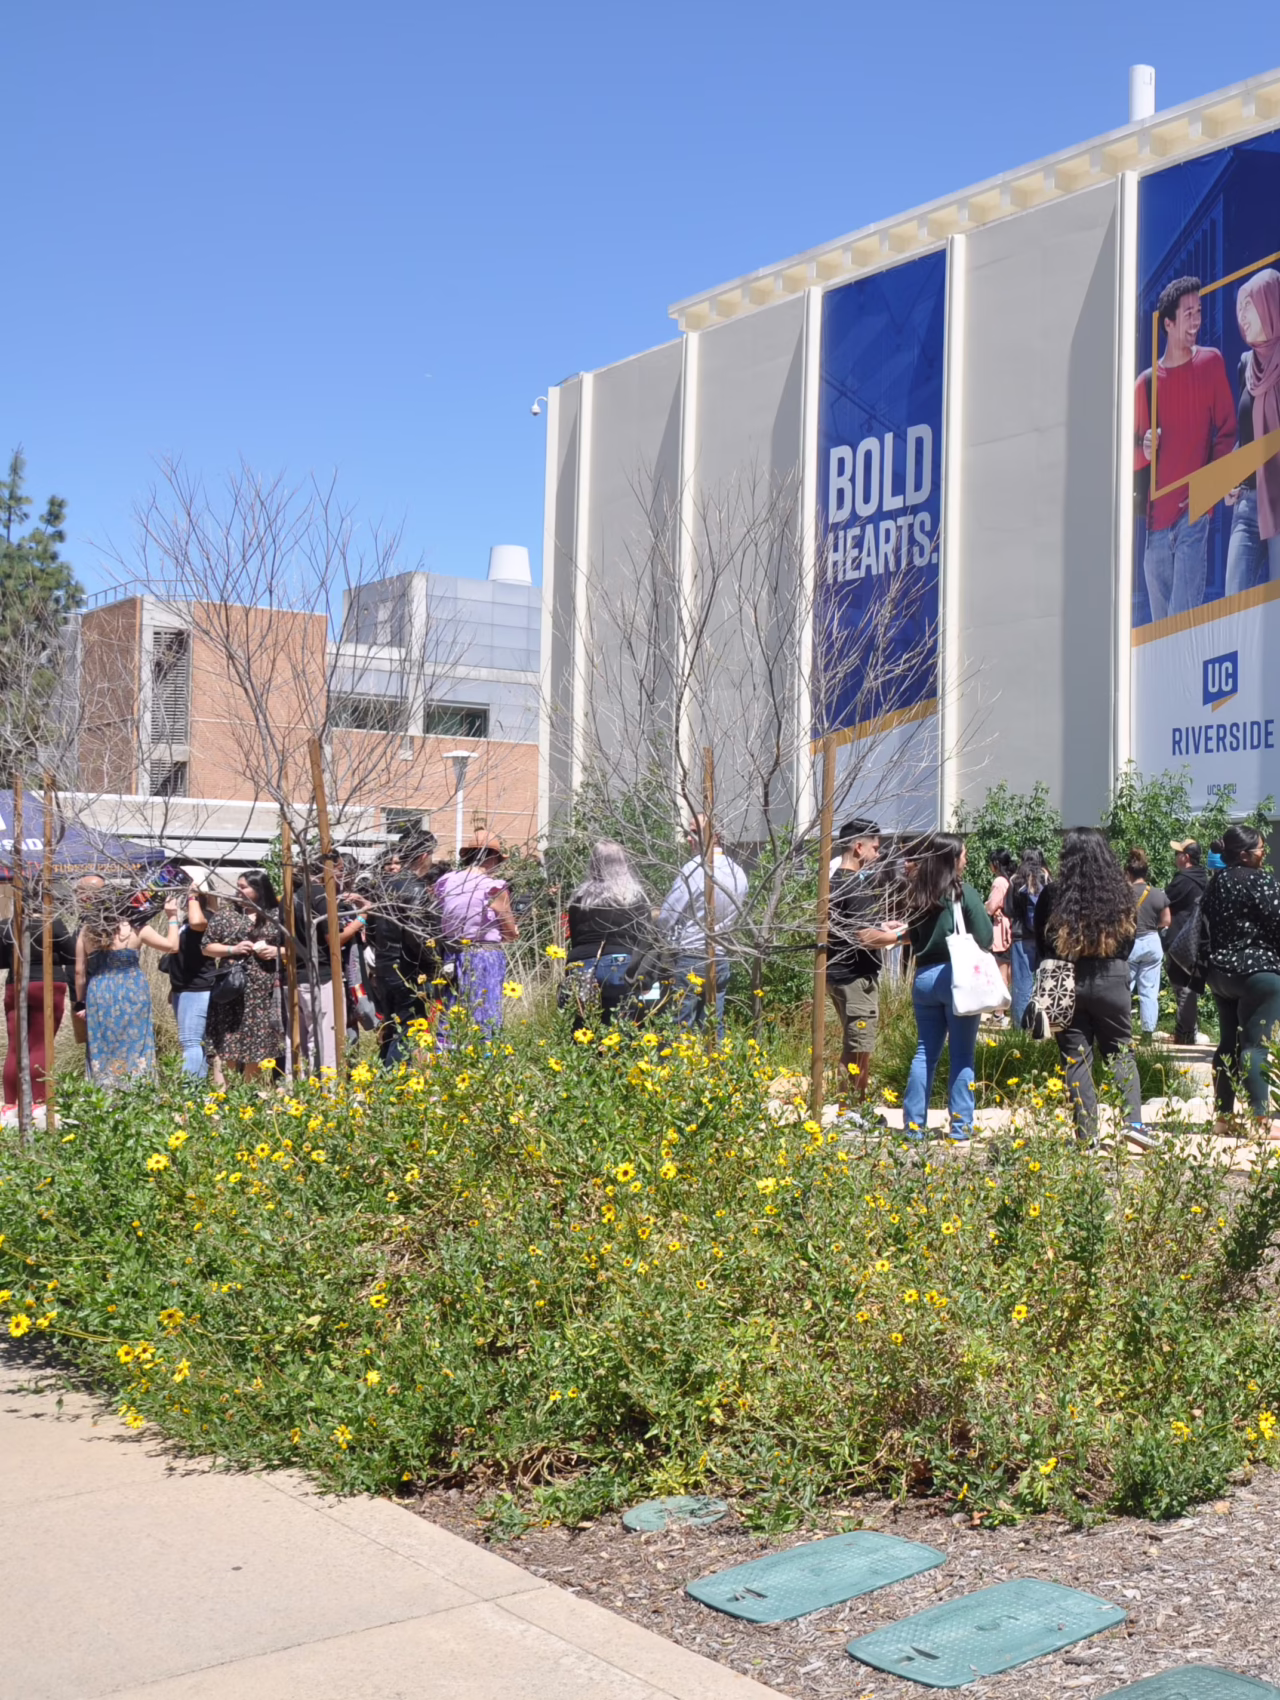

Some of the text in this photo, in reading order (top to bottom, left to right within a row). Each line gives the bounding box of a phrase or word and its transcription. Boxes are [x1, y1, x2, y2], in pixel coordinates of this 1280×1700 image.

[828, 423, 933, 524] BOLD
[826, 511, 938, 584] HEARTS.
[1208, 661, 1234, 693] UC
[1172, 719, 1275, 756] RIVERSIDE
